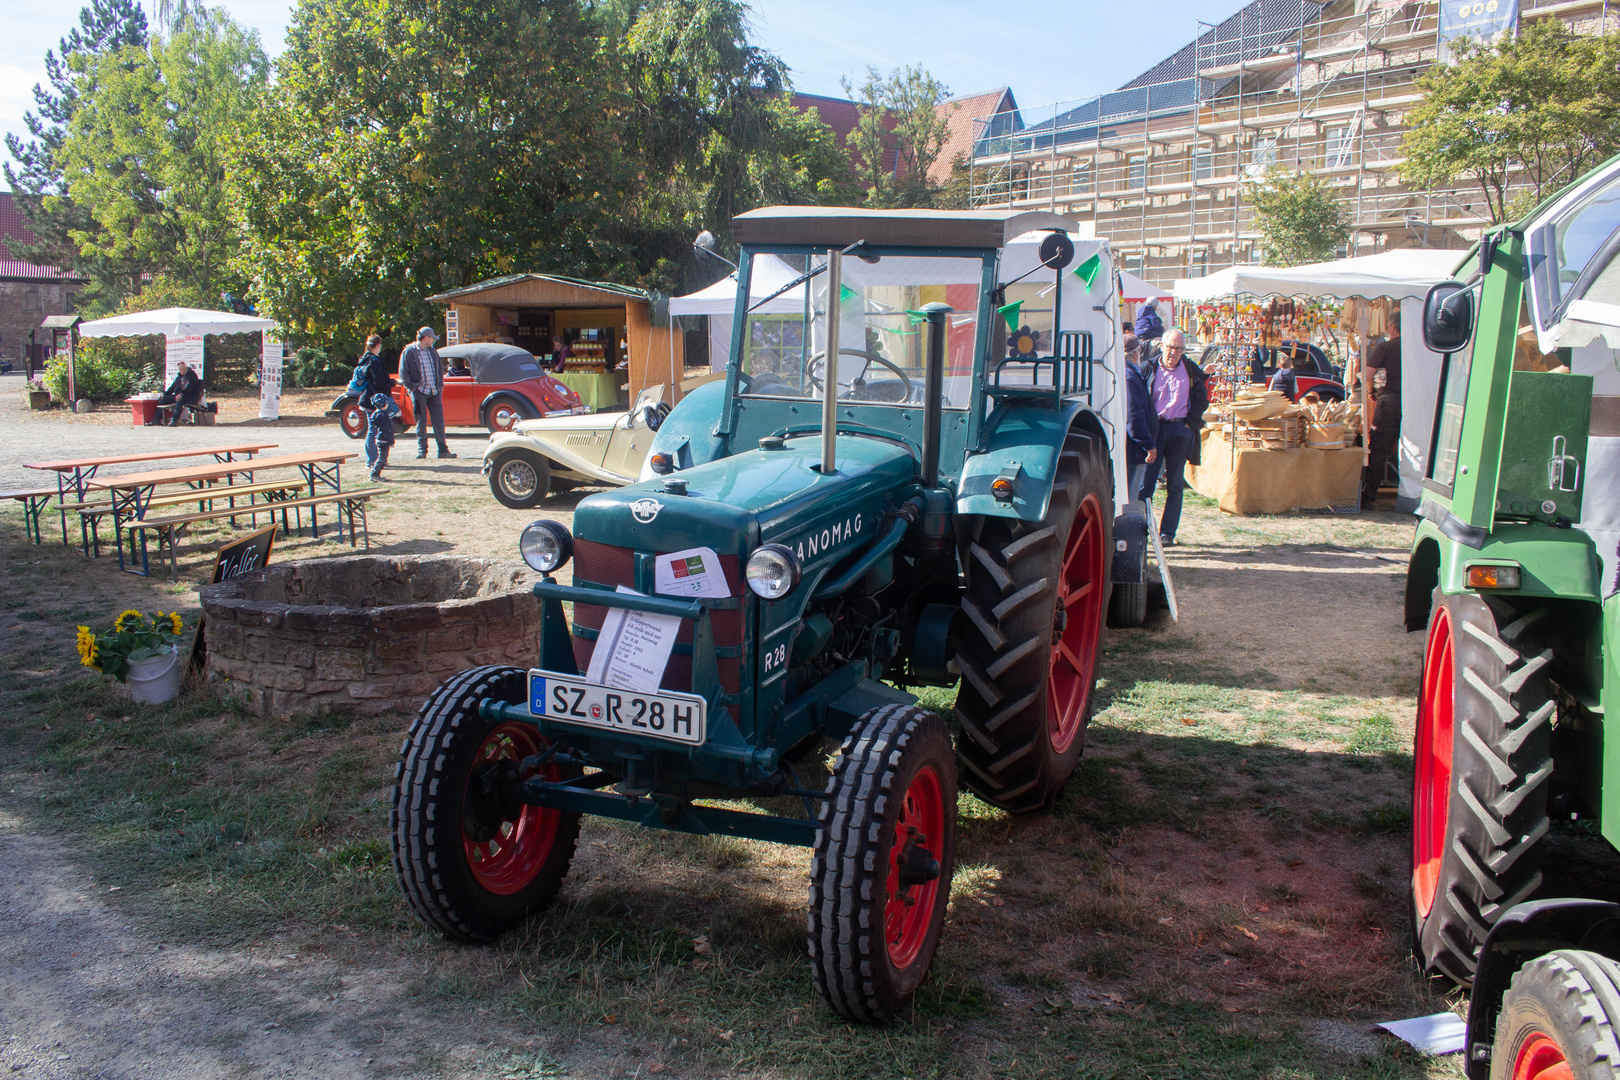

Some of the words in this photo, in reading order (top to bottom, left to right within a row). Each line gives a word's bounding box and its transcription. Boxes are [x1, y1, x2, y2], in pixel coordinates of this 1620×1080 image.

[790, 513, 862, 562] ANOMAG
[764, 652, 772, 673] R
[773, 644, 785, 667] 28
[535, 699, 541, 708] D
[552, 686, 587, 718] SZ
[606, 693, 624, 724] R
[632, 698, 665, 731] 28
[673, 704, 692, 735] H
